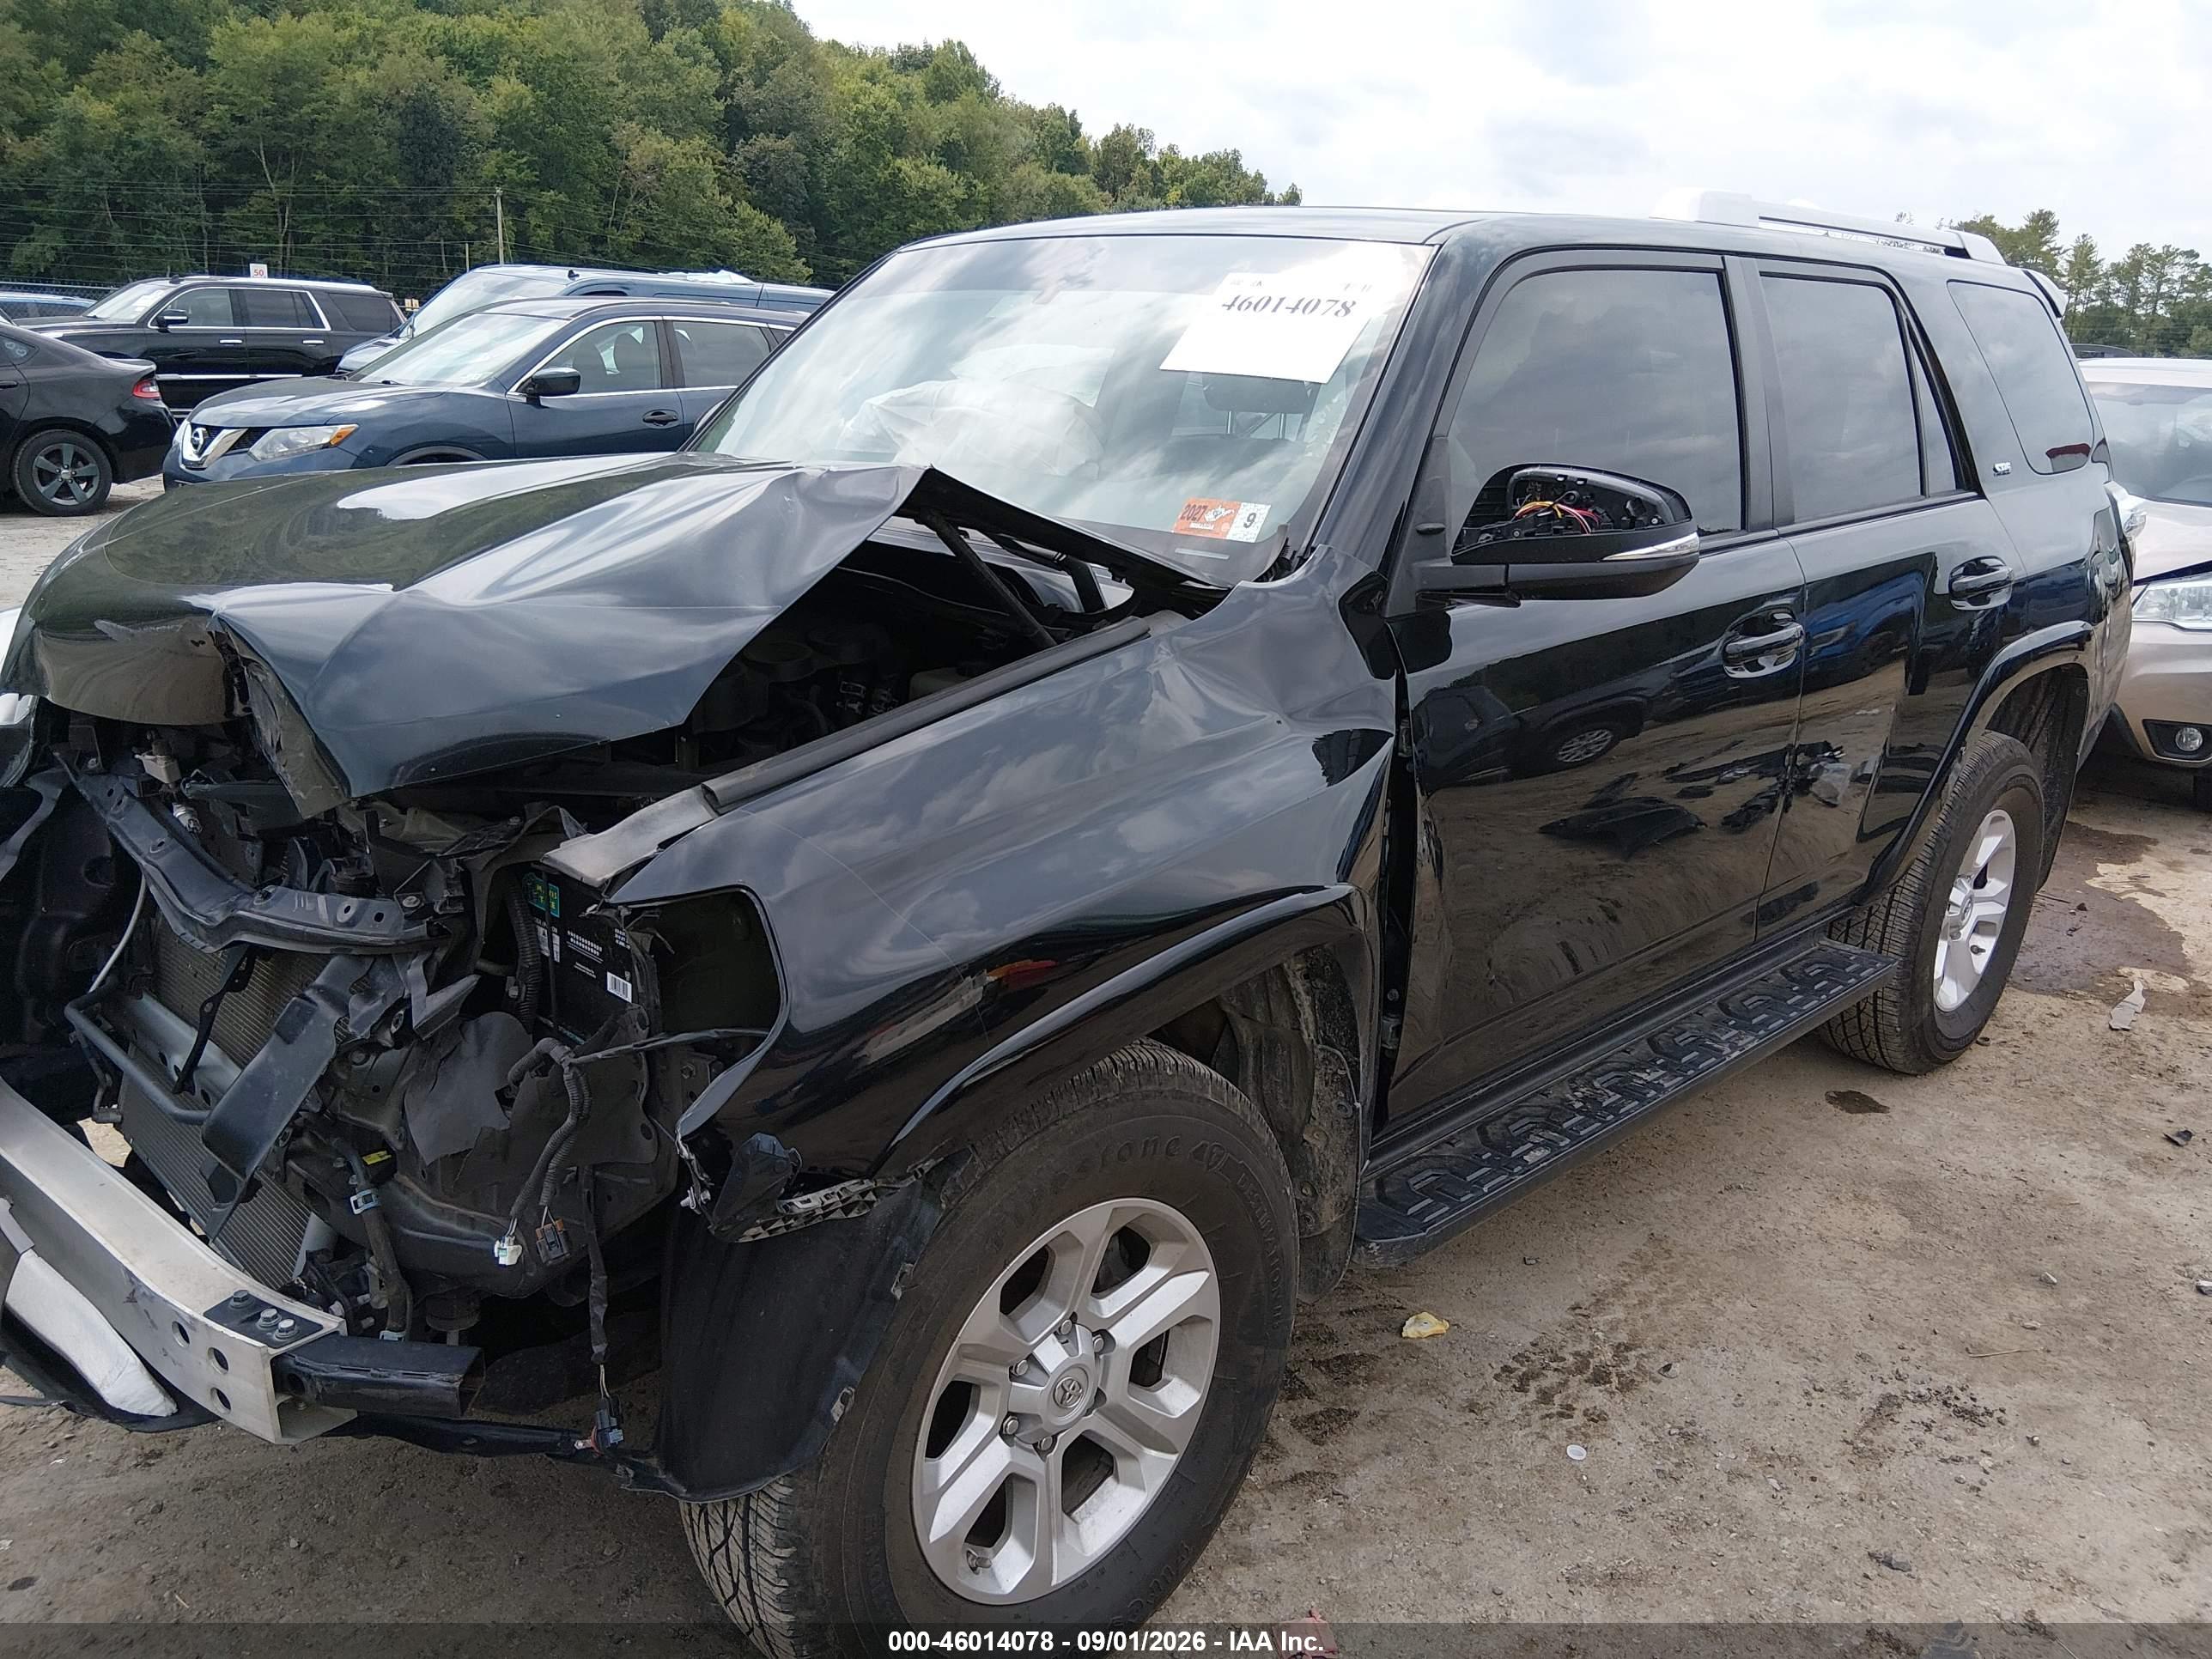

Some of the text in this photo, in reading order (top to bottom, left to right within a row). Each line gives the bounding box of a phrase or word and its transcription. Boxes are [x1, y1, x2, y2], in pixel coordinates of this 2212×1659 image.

[1221, 294, 1358, 318] 46014078
[1180, 503, 1209, 522] 2027
[1243, 512, 1257, 529] 9
